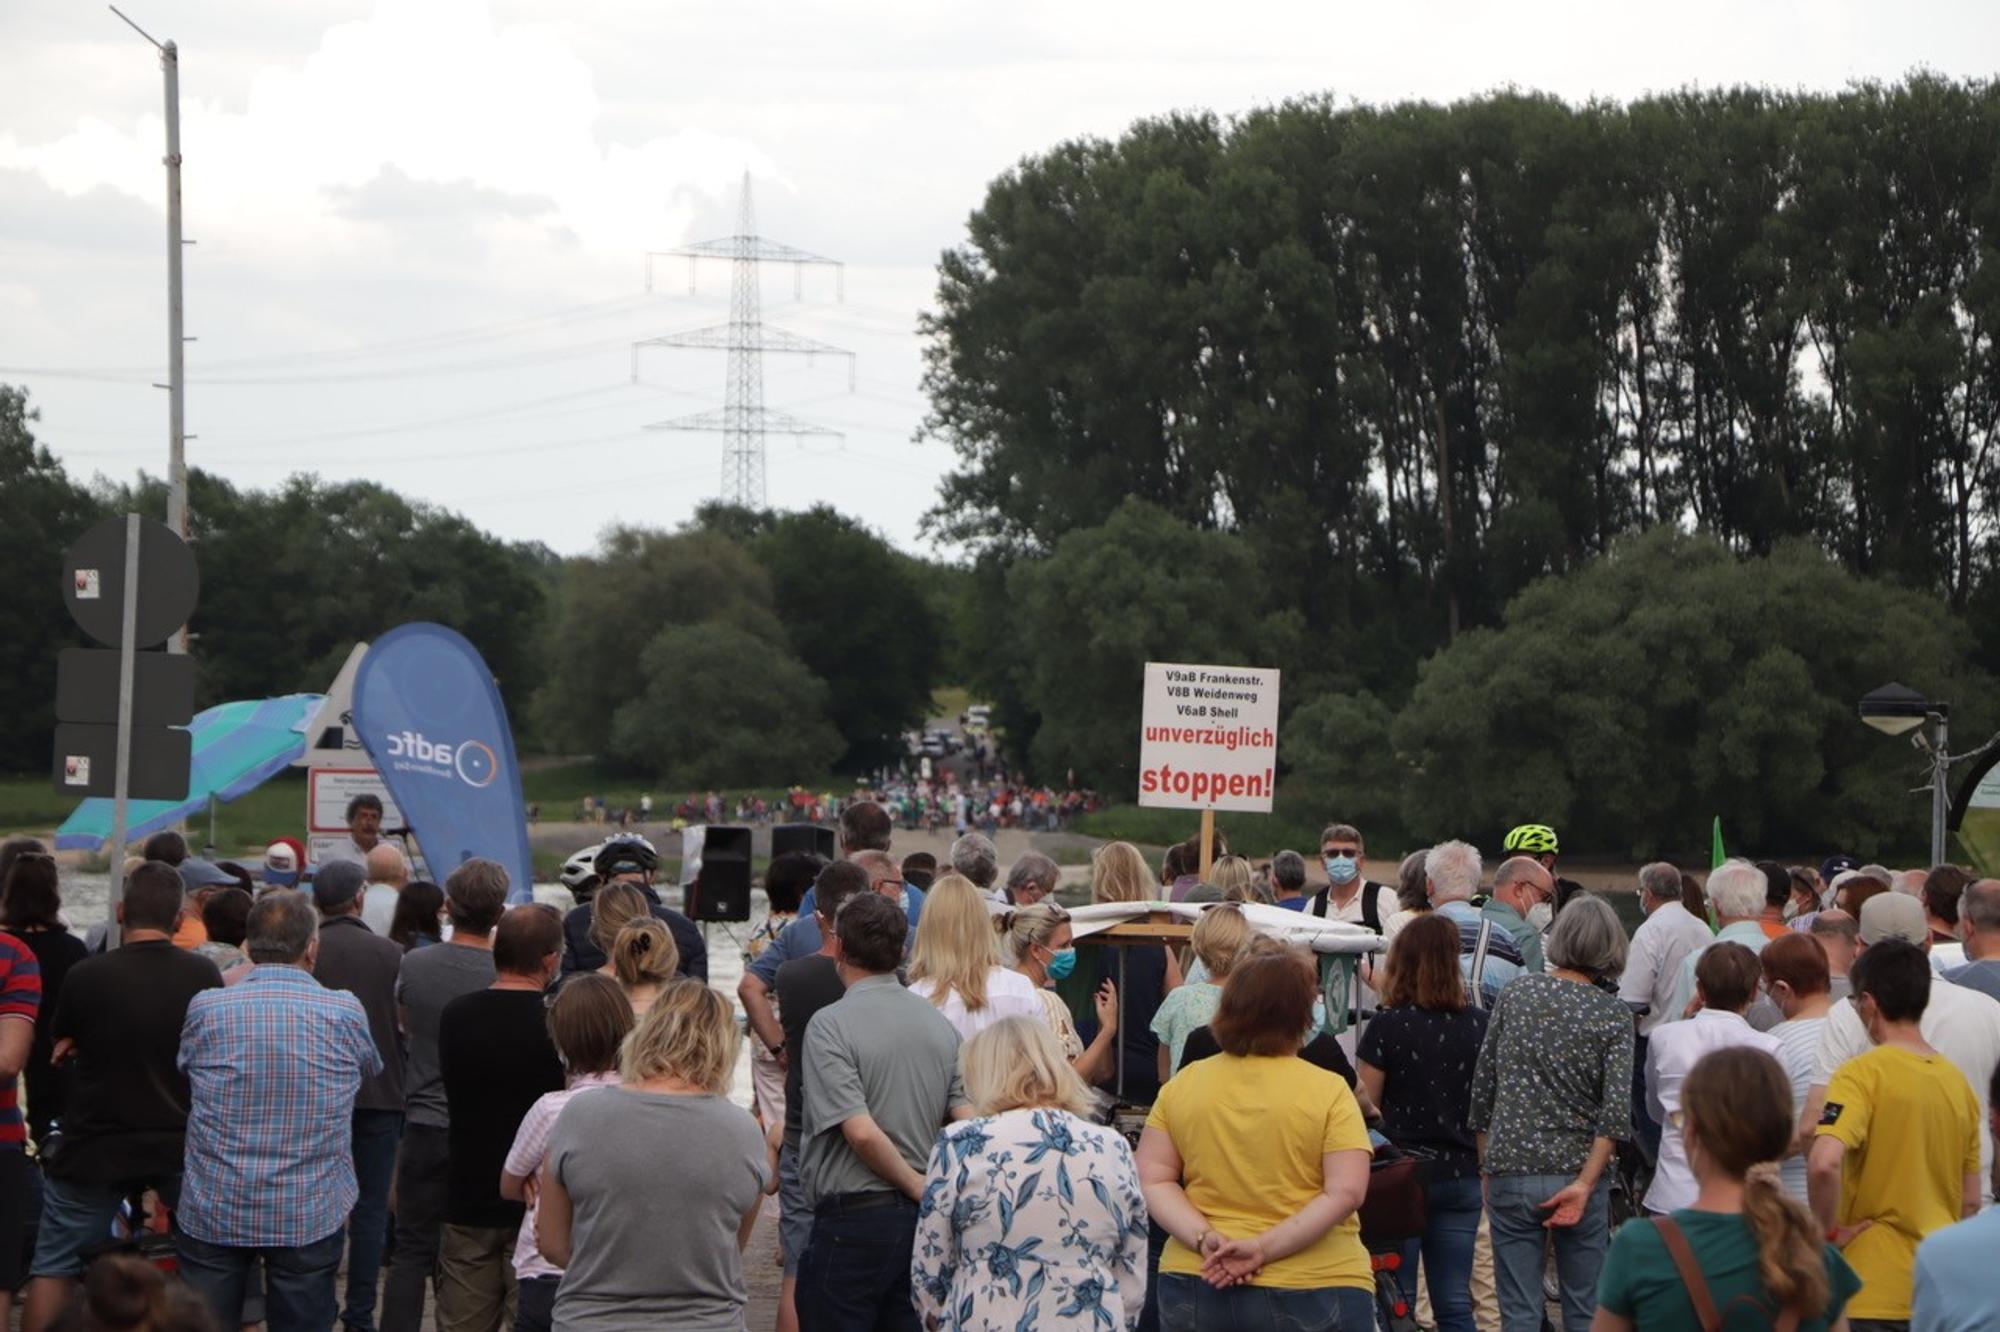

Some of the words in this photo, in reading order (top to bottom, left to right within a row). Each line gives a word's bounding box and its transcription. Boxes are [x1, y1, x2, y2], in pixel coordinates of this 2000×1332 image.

[1166, 671, 1197, 682] V9aB
[1200, 672, 1263, 686] Frankenstr.
[1193, 688, 1258, 703] Weidenweg
[1176, 705, 1206, 716] V6aB
[1210, 707, 1239, 718] Shell
[1146, 726, 1273, 750] unverzüglich
[1142, 765, 1272, 801] stoppen!
